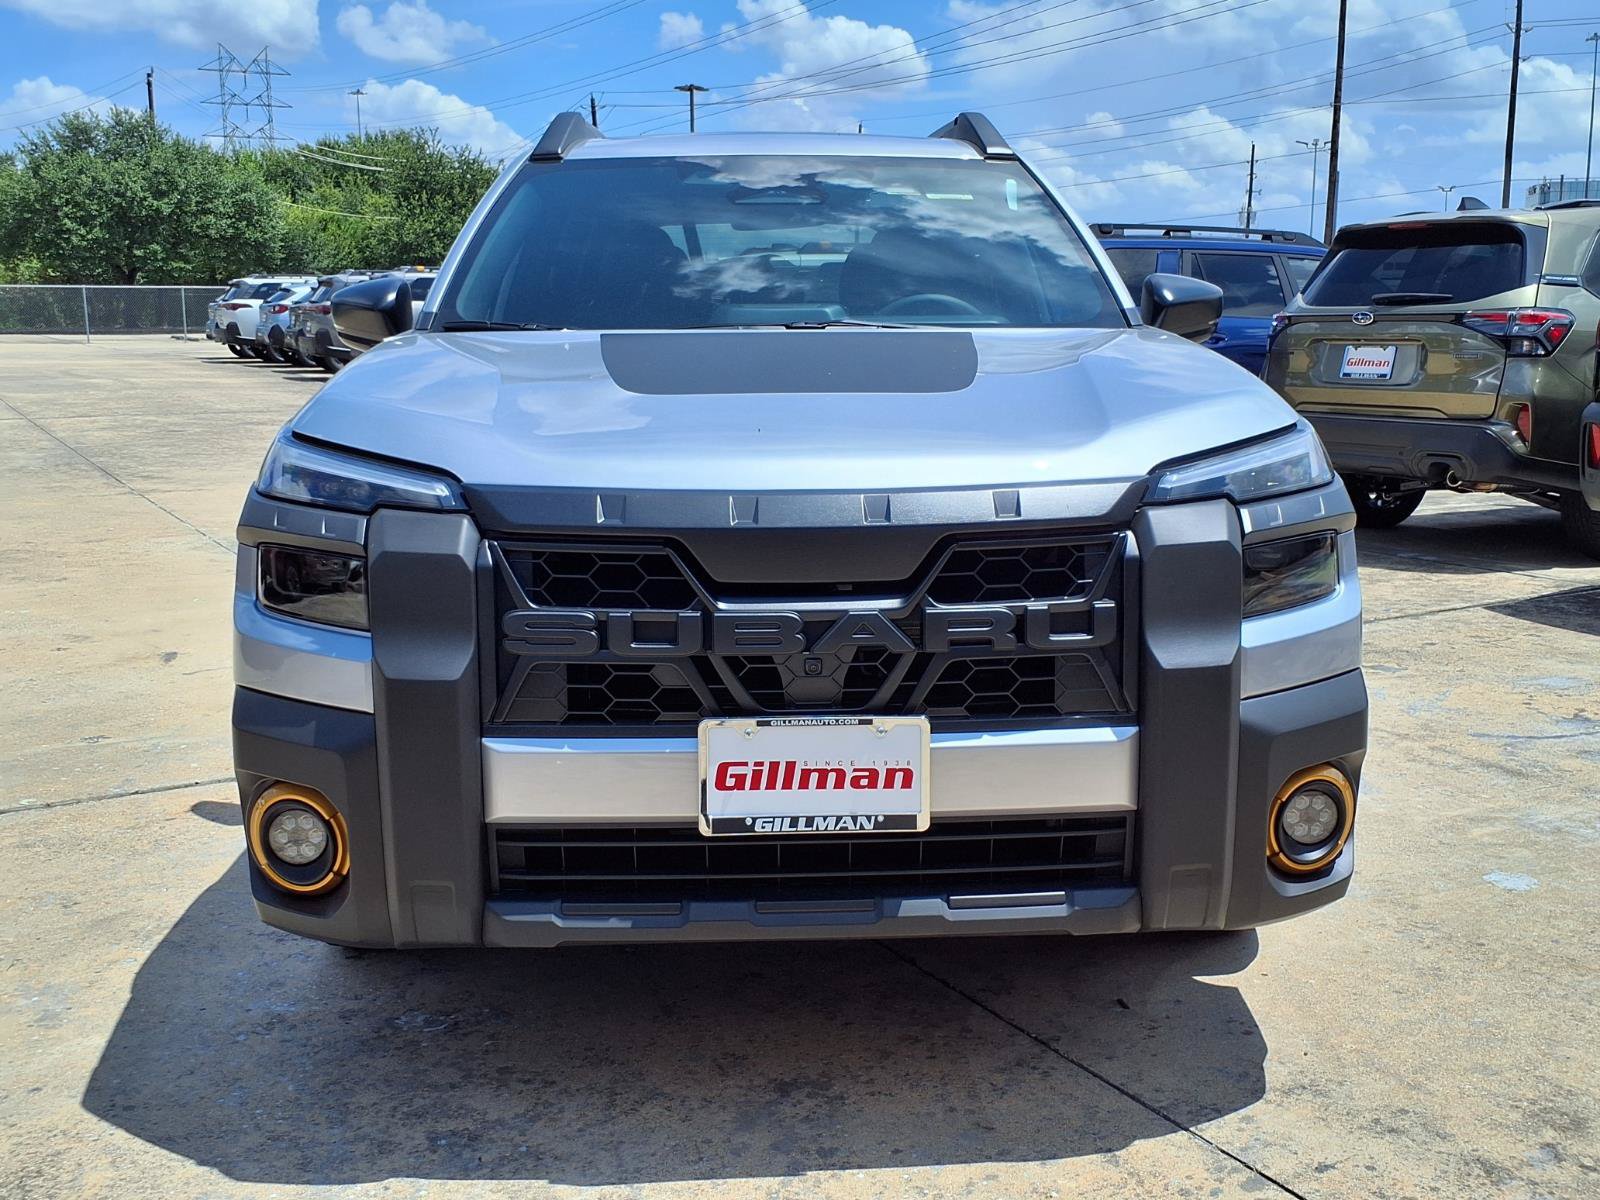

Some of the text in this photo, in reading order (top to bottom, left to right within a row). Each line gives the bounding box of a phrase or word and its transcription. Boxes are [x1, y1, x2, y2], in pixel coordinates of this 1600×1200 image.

[1346, 357, 1390, 368] Gillman
[501, 599, 1118, 657] SUBARU
[770, 718, 859, 727] GILLMANAUTO.COM
[714, 760, 914, 792] Gillman
[754, 815, 876, 832] GILLMAN
